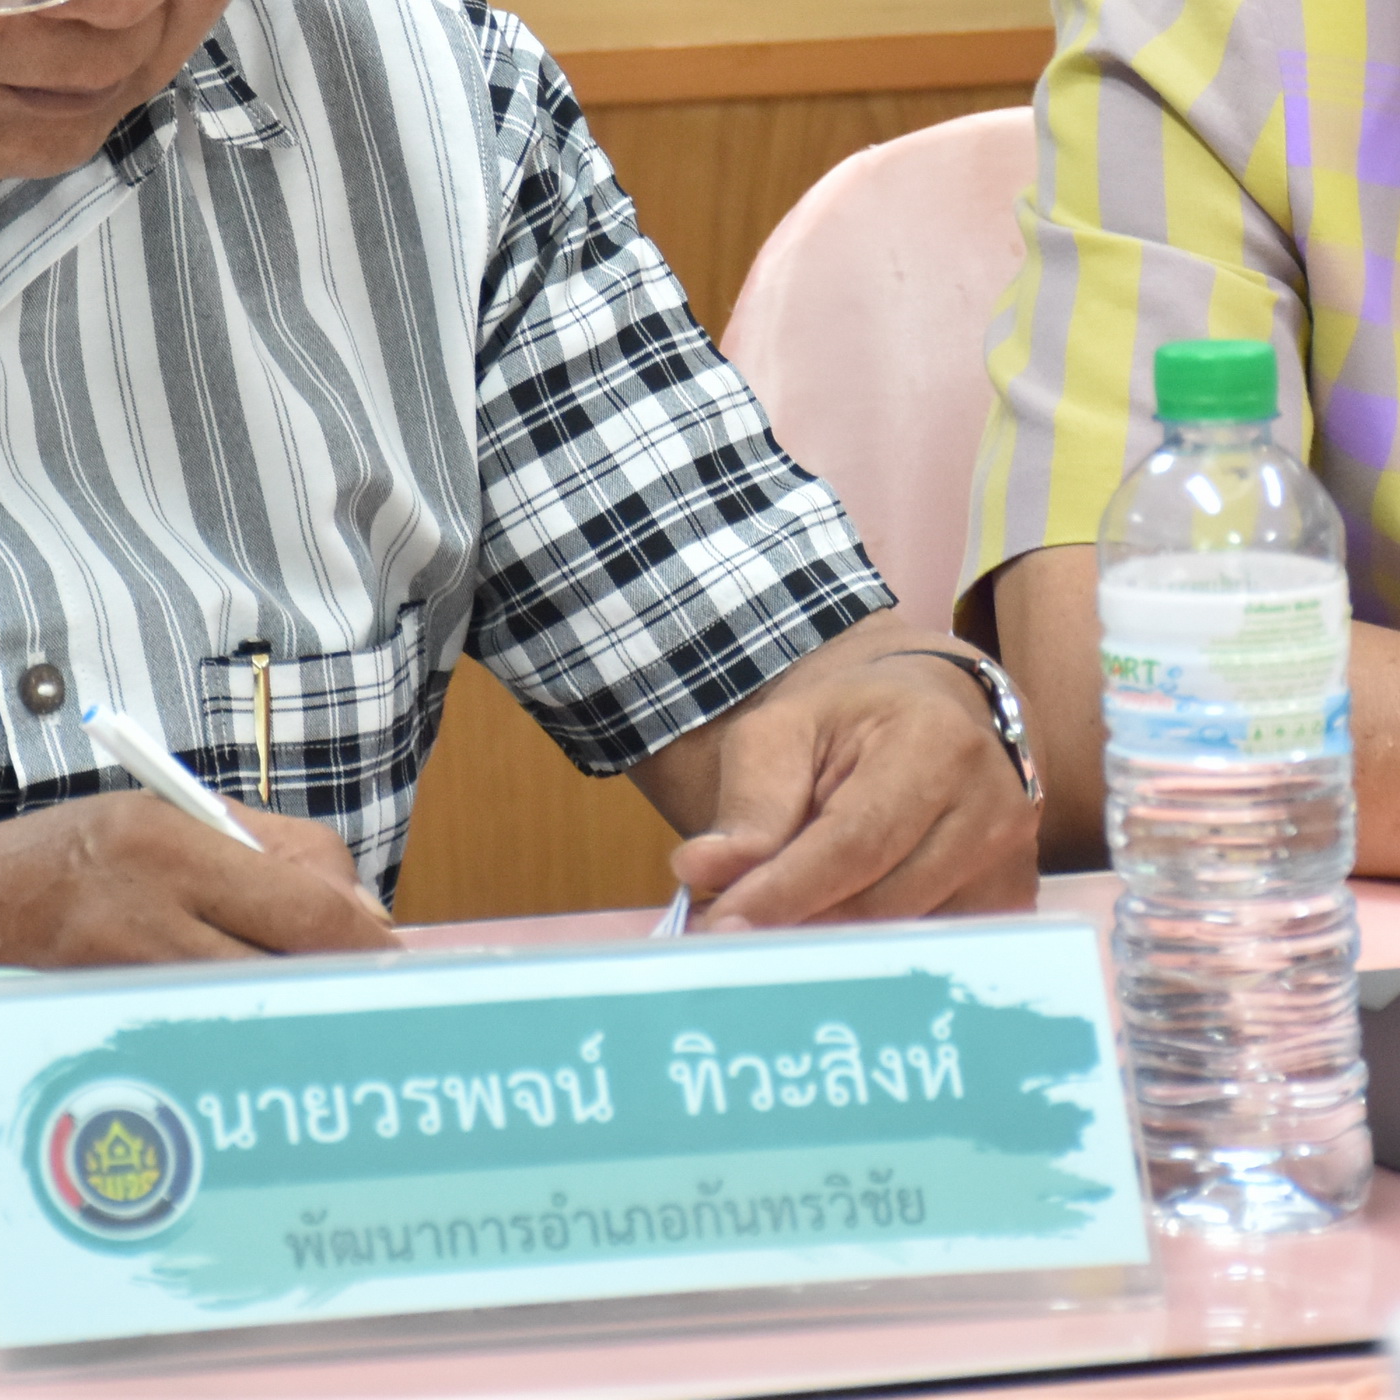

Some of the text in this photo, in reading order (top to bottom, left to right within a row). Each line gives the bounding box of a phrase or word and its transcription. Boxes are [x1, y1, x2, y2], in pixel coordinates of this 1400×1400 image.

[198, 1008, 964, 1151] นายวรพจน์ ทิวะสิงห์
[284, 1167, 927, 1271] พัฒนาการอำเภอกันทรวิชัย
